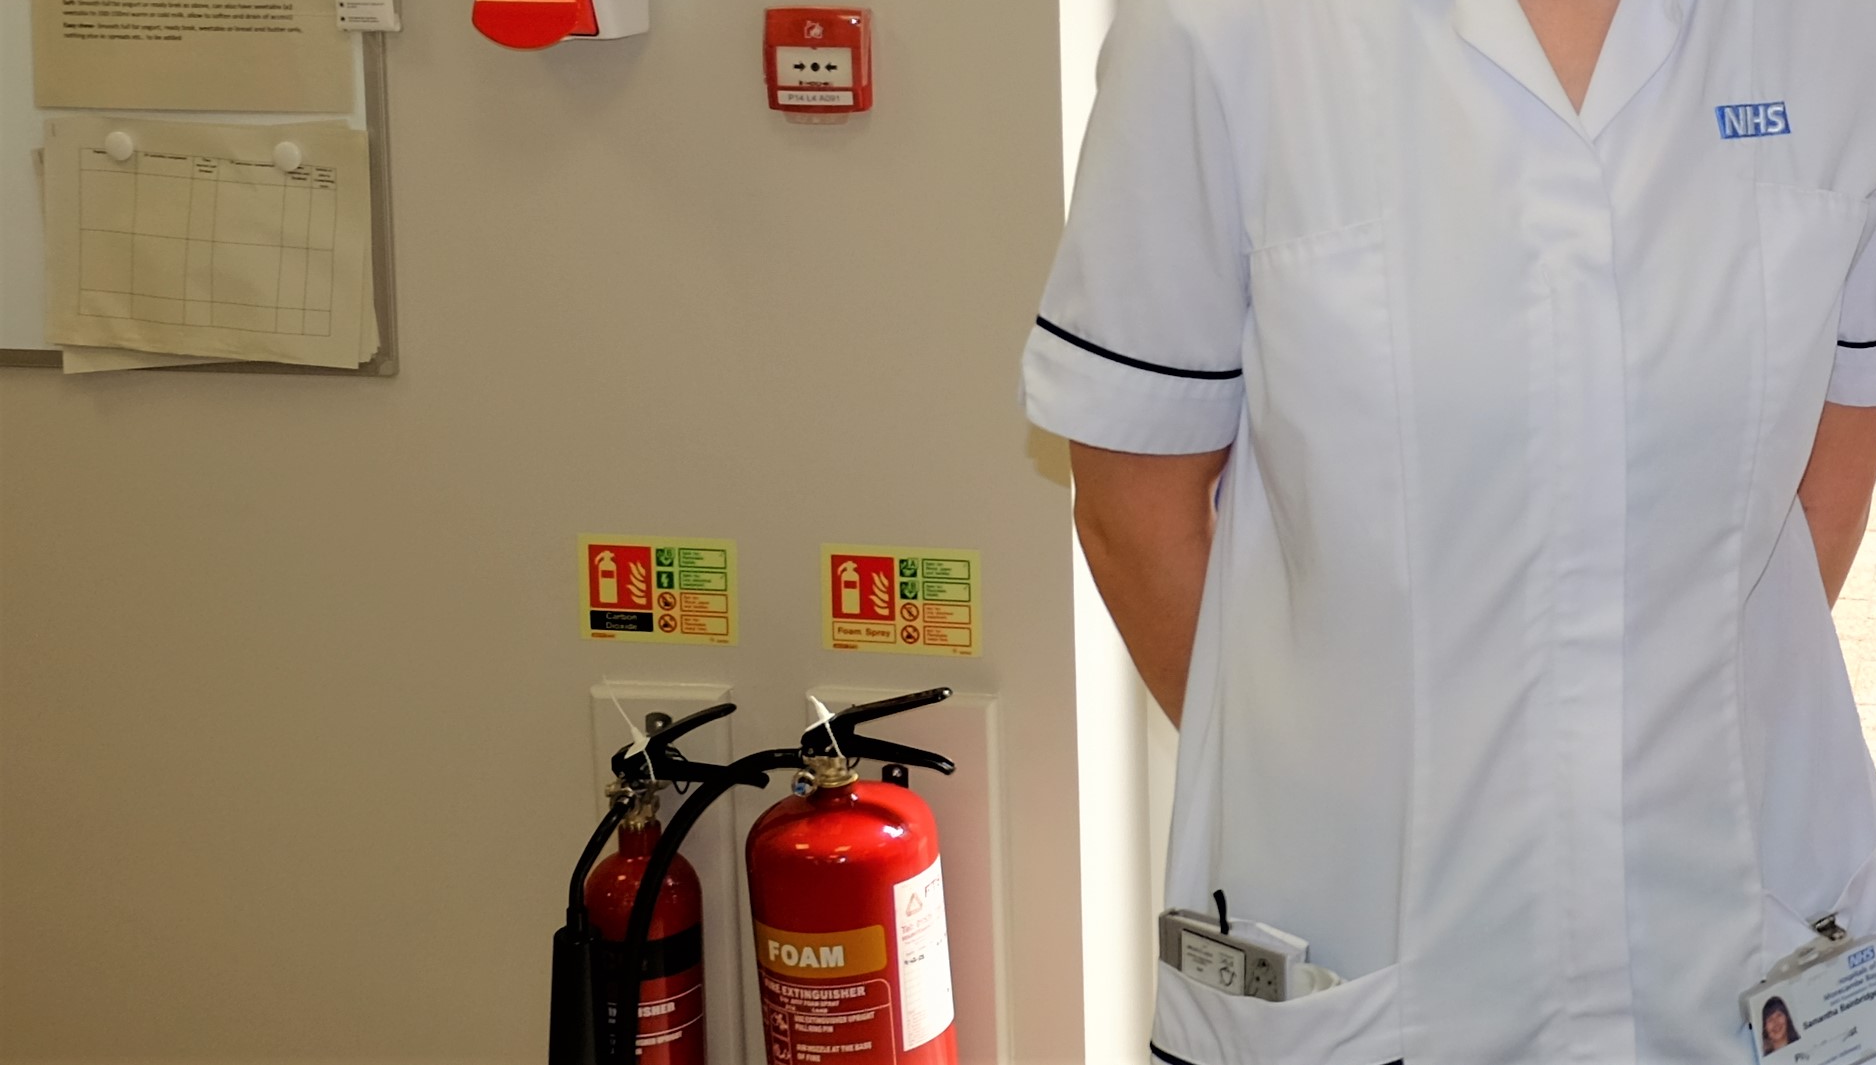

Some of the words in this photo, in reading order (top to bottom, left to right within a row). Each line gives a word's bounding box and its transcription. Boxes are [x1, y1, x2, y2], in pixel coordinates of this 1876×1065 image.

[1723, 104, 1785, 137] NHS
[605, 612, 637, 620] Carbon
[605, 622, 637, 630] Dioxide
[837, 627, 862, 635] Foam
[865, 628, 890, 637] Spray
[768, 939, 845, 968] FOAM
[1848, 946, 1876, 968] NHS
[782, 985, 866, 1000] EXTINGUISHER
